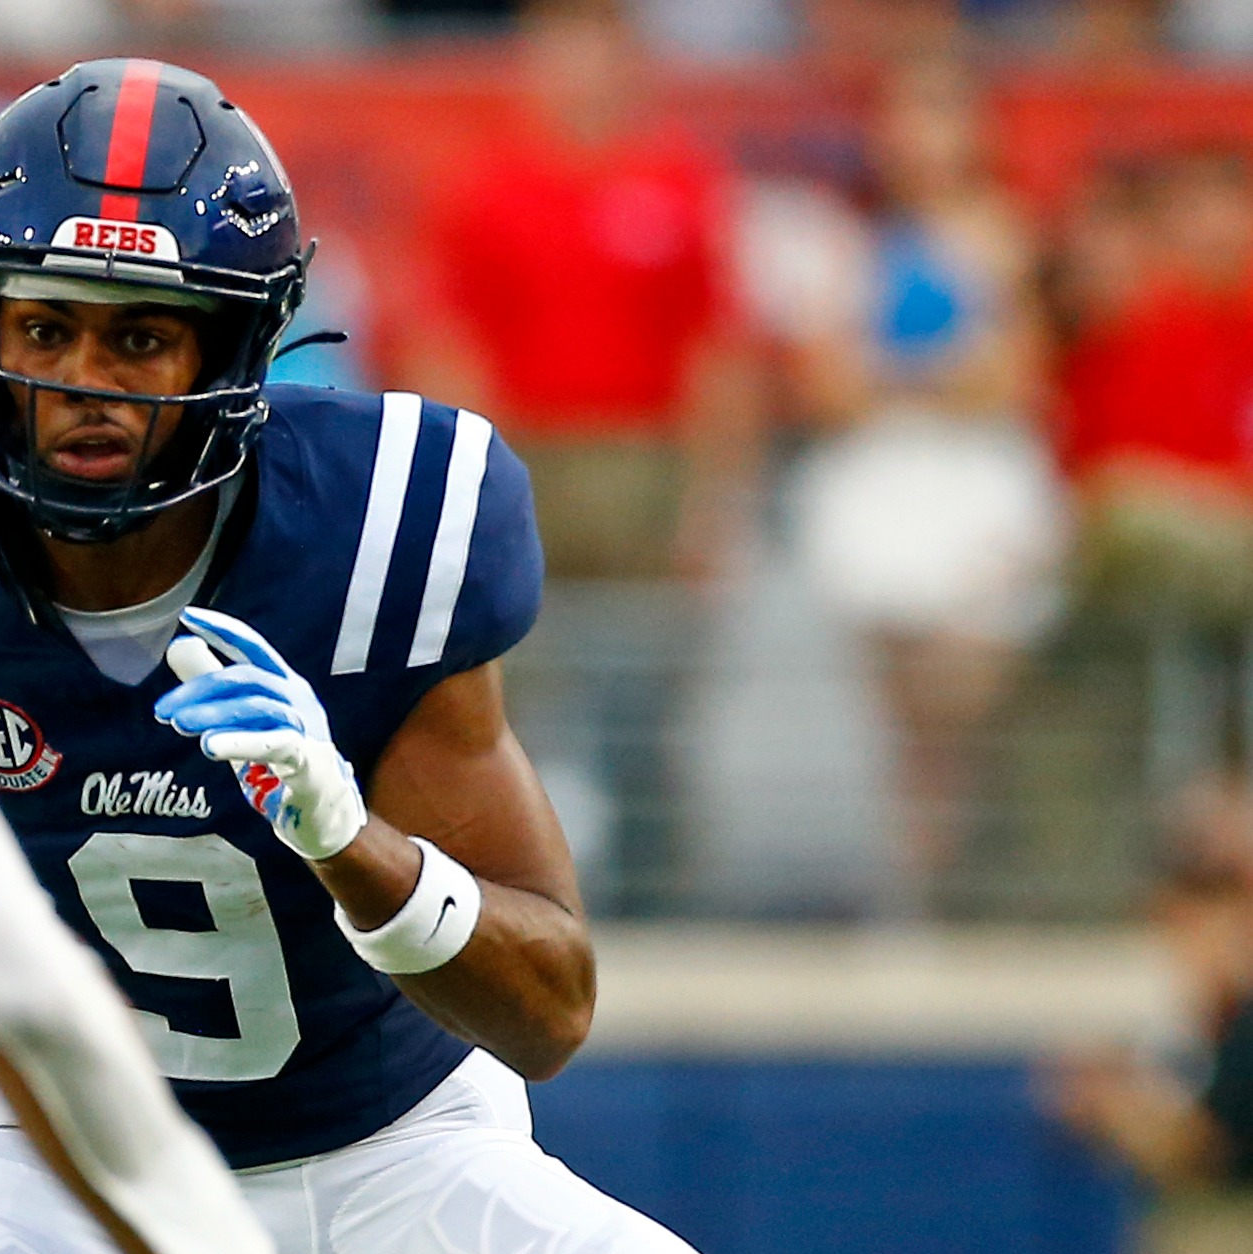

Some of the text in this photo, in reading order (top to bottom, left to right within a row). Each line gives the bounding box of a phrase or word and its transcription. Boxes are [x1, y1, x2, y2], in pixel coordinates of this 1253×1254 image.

[73, 221, 157, 254] REBS
[80, 770, 212, 819] Ole Miss
[68, 832, 301, 1082] 9
